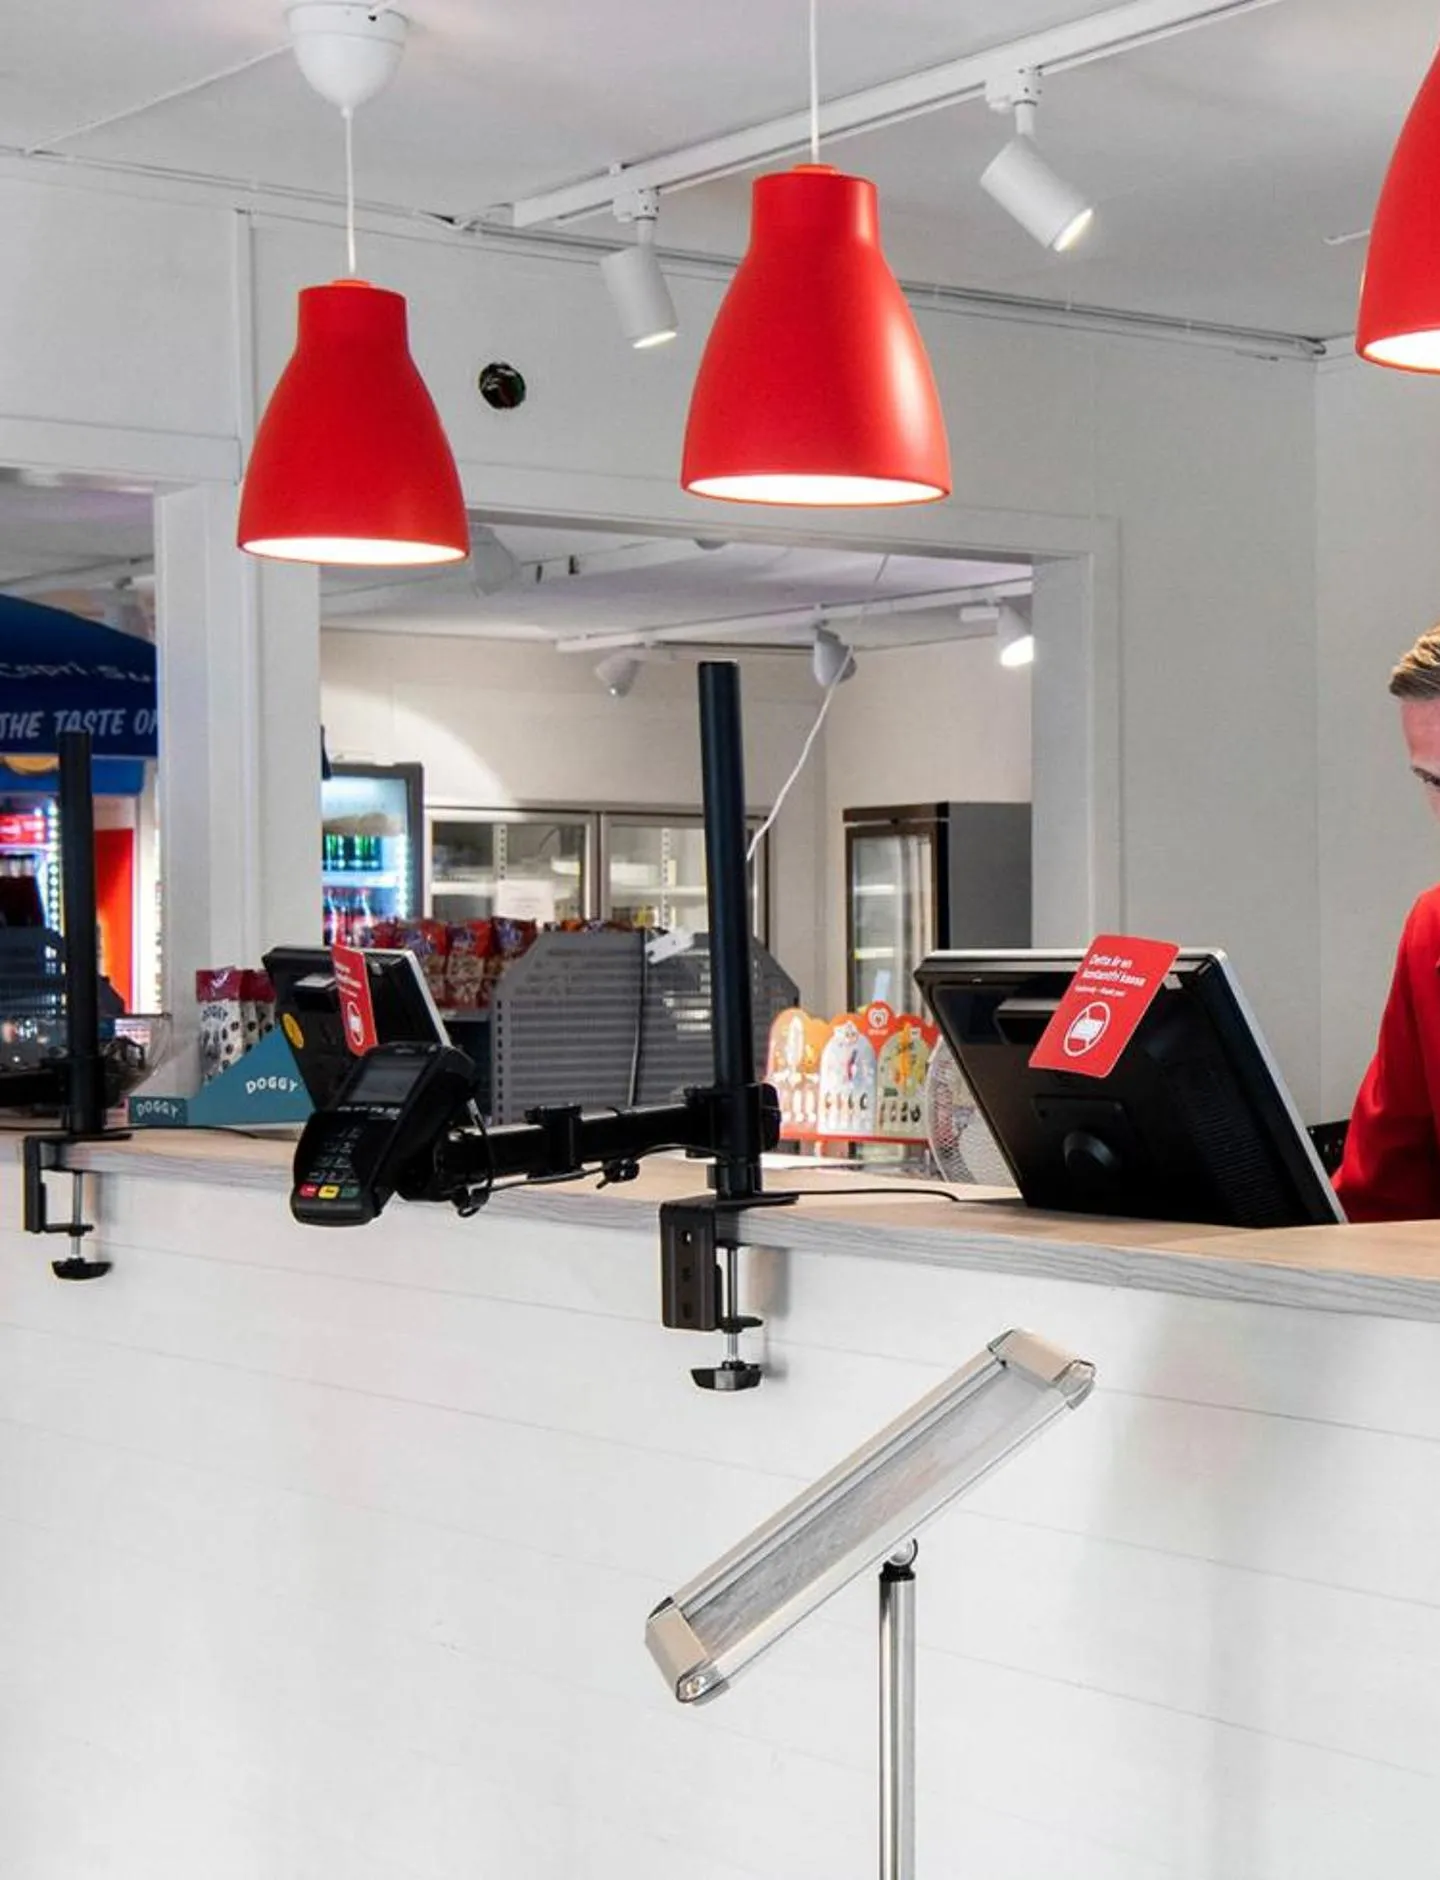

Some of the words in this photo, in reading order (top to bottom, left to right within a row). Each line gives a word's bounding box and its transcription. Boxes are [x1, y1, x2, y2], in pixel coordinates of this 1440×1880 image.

[0, 711, 44, 739] THE
[53, 708, 127, 737] TASTE
[245, 1076, 298, 1095] DOGGY
[136, 1101, 178, 1119] DOGGY
